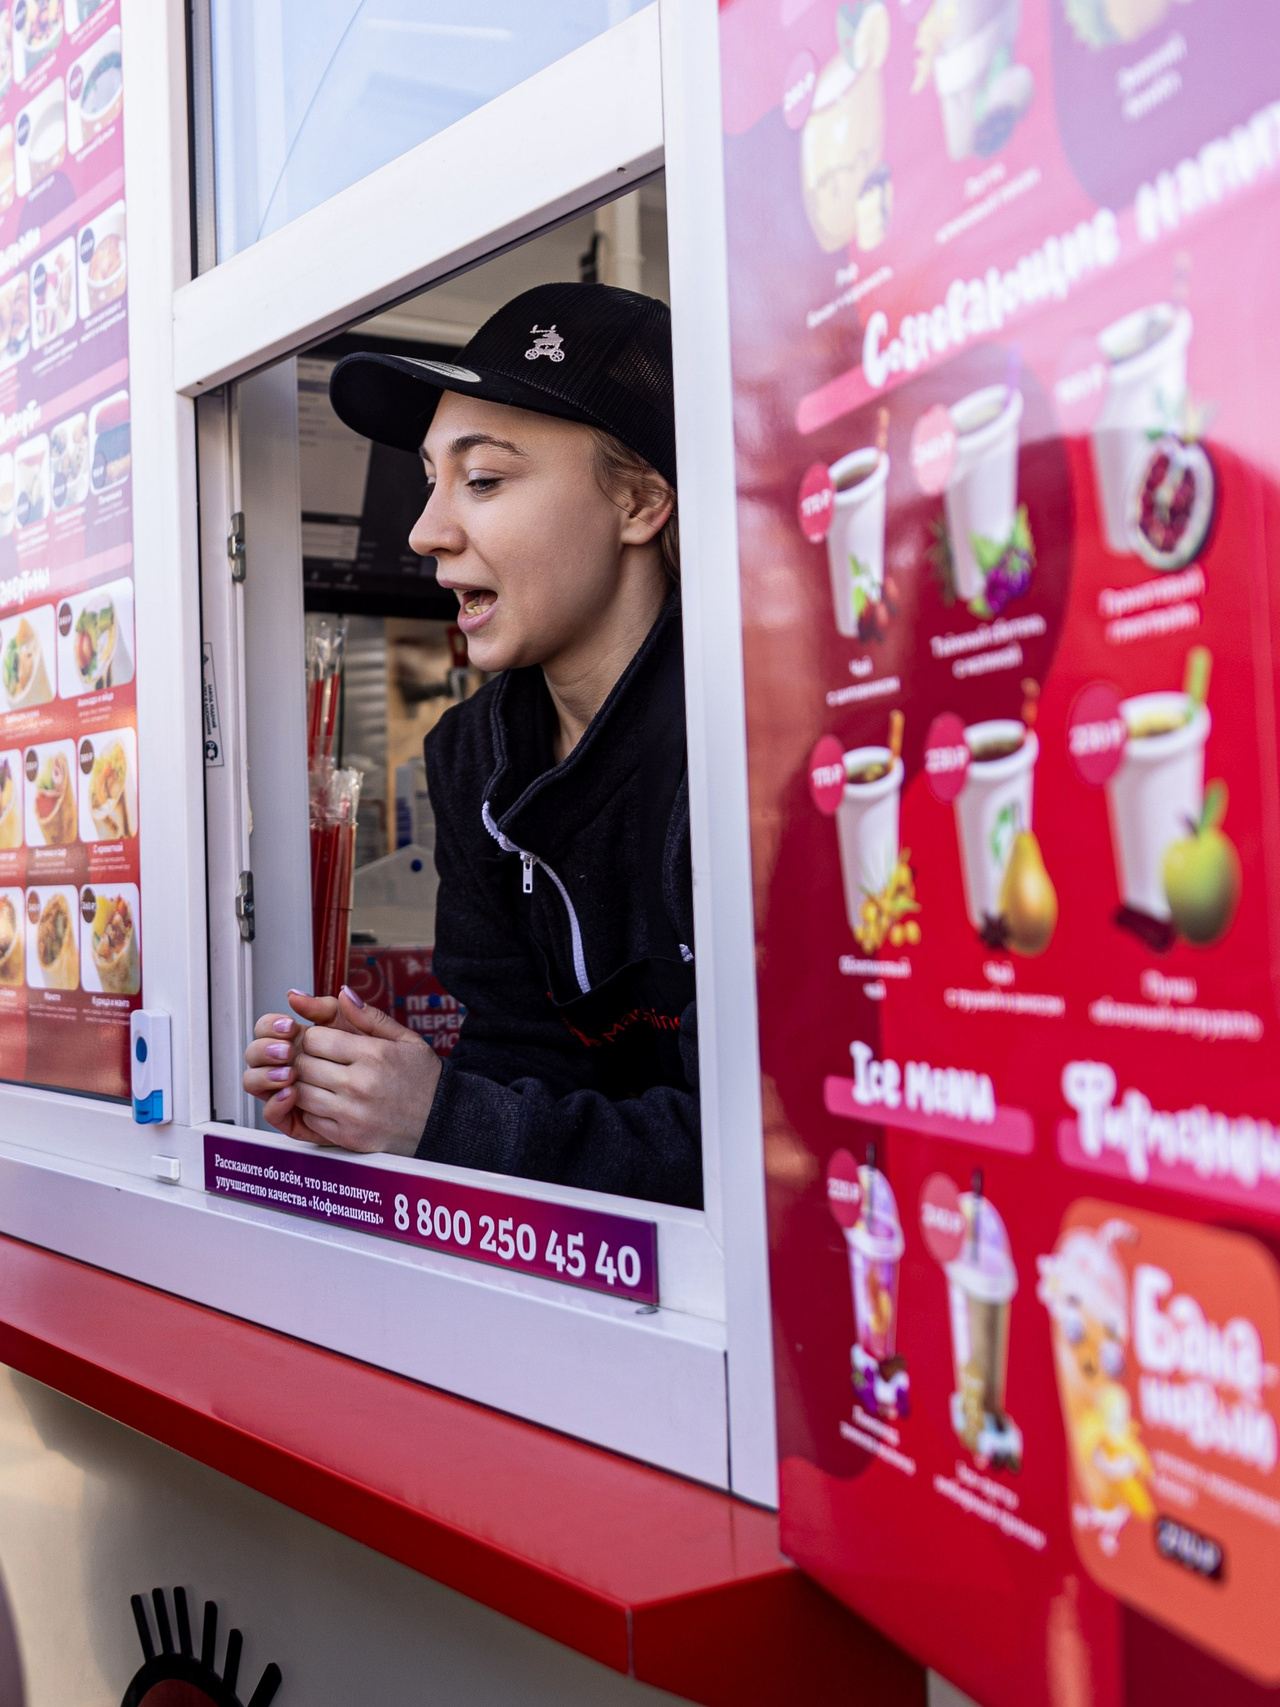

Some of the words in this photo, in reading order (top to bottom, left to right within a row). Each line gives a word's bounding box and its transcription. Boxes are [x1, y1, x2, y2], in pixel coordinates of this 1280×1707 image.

[214, 1153, 263, 1177] Расскажите
[264, 1166, 279, 1180] обо
[280, 1170, 304, 1188] всём,
[304, 1176, 321, 1190] что
[322, 1181, 338, 1194] вас
[339, 1184, 383, 1205] волнует,
[216, 1175, 267, 1198] улучшателю
[268, 1188, 308, 1207] качества
[308, 1195, 384, 1225] «Кофемашины»
[394, 1193, 410, 1231] 8
[416, 1198, 472, 1246] 800
[478, 1215, 537, 1262] 250
[544, 1229, 587, 1278] 45
[594, 1240, 642, 1287] 40
